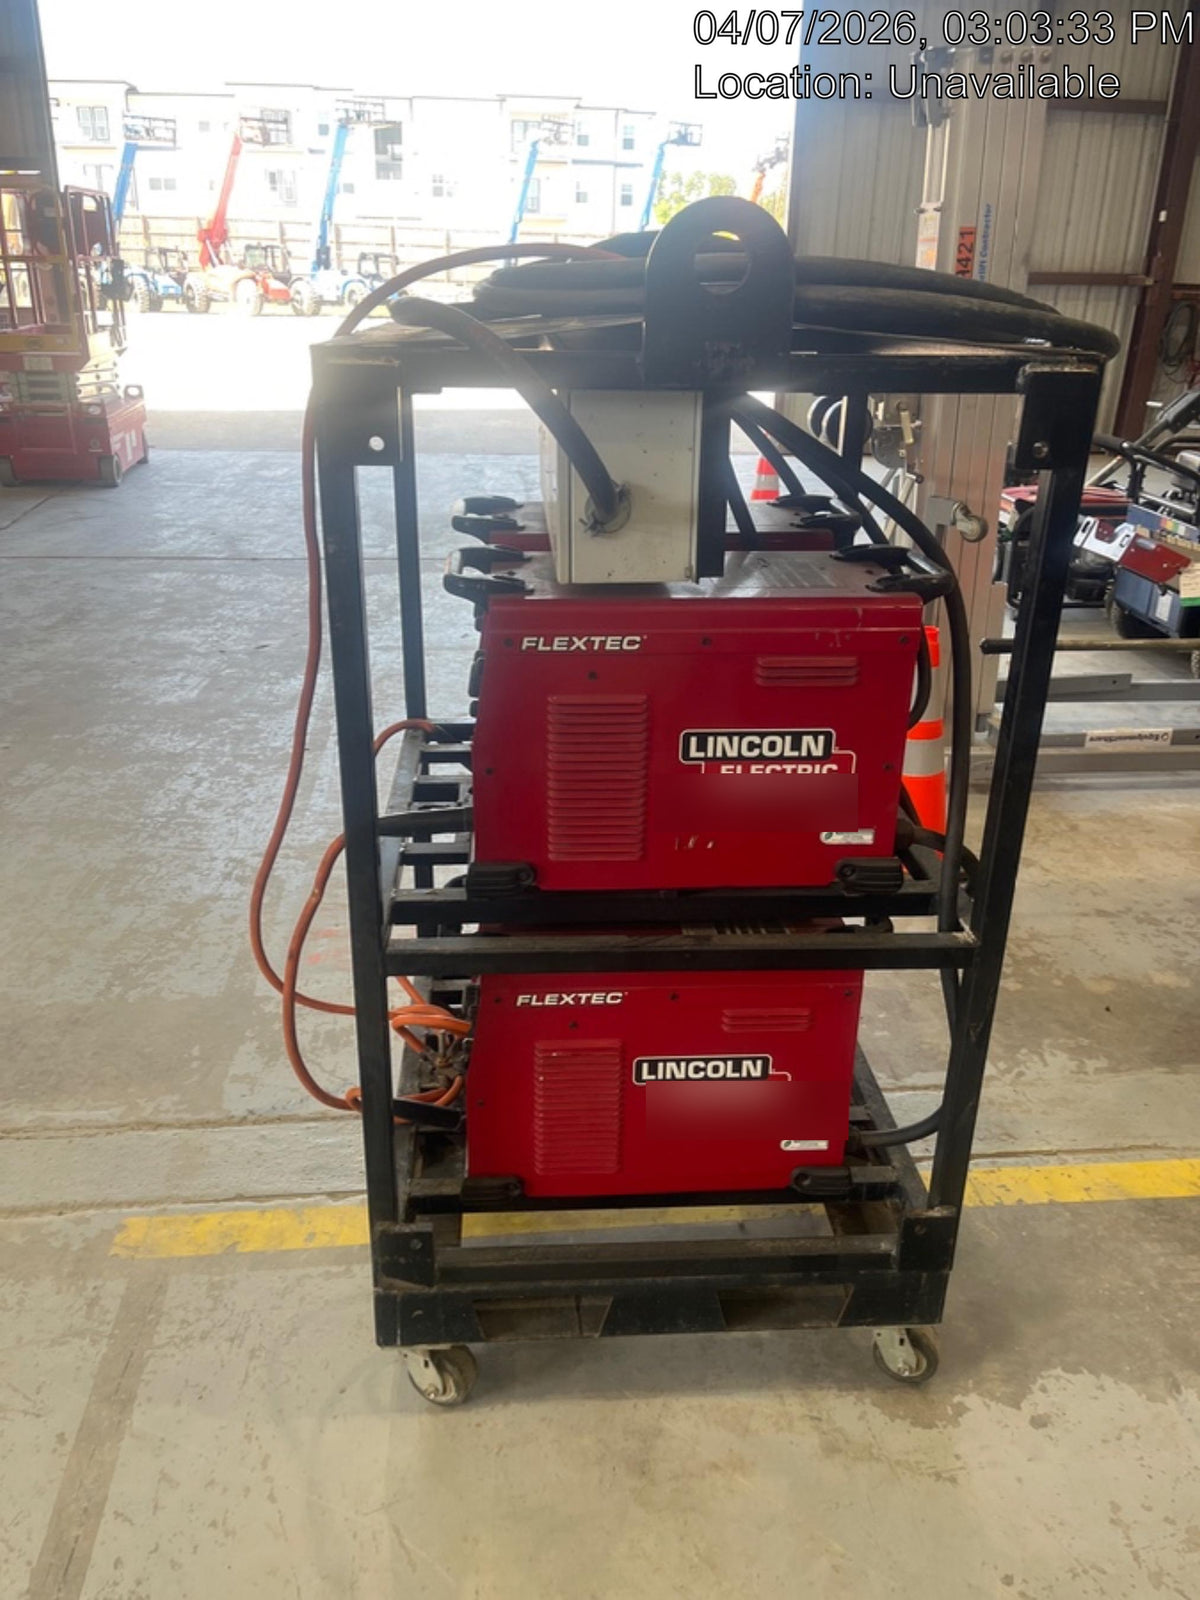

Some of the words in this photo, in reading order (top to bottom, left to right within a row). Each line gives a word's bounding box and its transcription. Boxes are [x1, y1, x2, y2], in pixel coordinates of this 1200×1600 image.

[521, 636, 641, 651] FLEXTEC
[689, 735, 825, 758] LINCOLN
[516, 992, 623, 1006] FLEXTEC
[641, 1059, 762, 1080] LINCOLN
